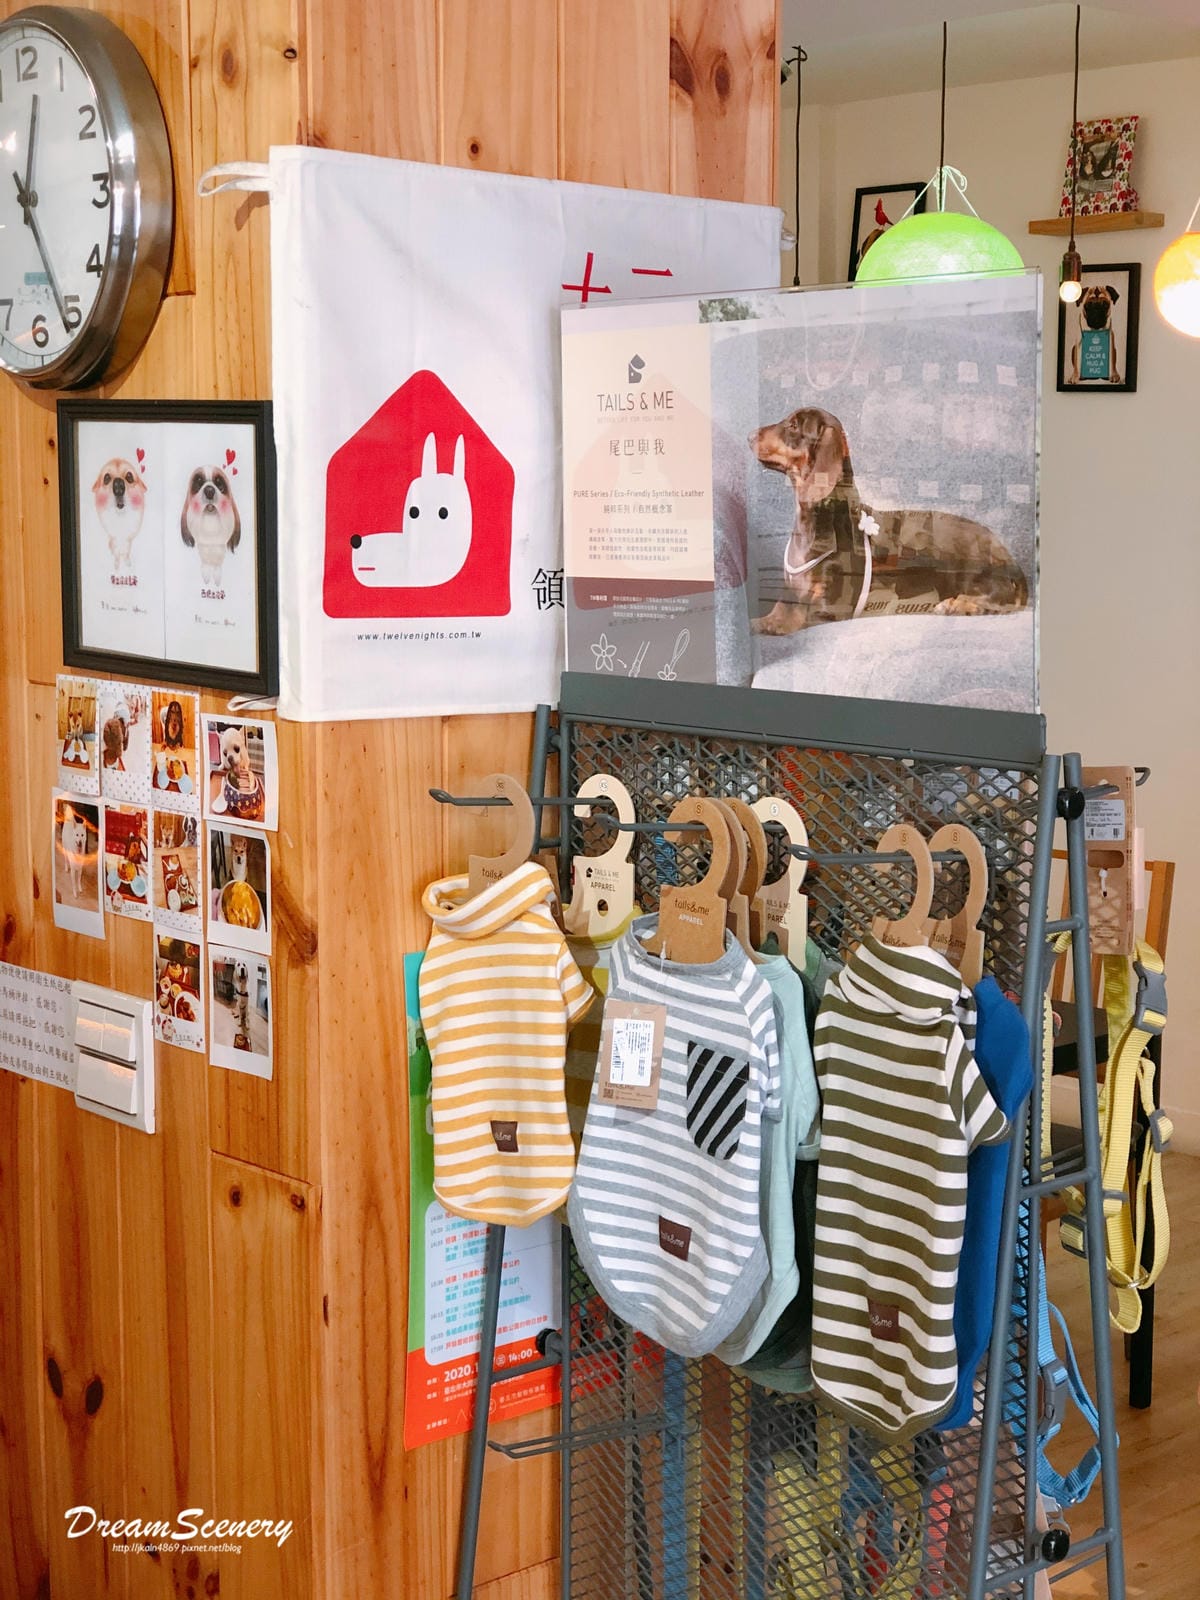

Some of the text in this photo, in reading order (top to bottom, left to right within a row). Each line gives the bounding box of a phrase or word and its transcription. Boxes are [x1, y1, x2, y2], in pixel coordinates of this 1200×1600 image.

[15, 46, 38, 82] 12
[78, 104, 97, 140] 2
[92, 171, 110, 209] 3
[86, 243, 104, 278] 4
[64, 295, 82, 329] 5
[31, 314, 49, 348] 6
[597, 390, 674, 412] TAILS & ME
[573, 490, 589, 498] PURE
[590, 490, 609, 498] Series
[681, 489, 705, 498] Leather
[531, 568, 565, 611] 領
[357, 631, 482, 642] www.twelvenights.com.tw
[590, 881, 616, 892] APPAREL
[674, 898, 710, 916] tails&me
[508, 1347, 533, 1364] 14:00
